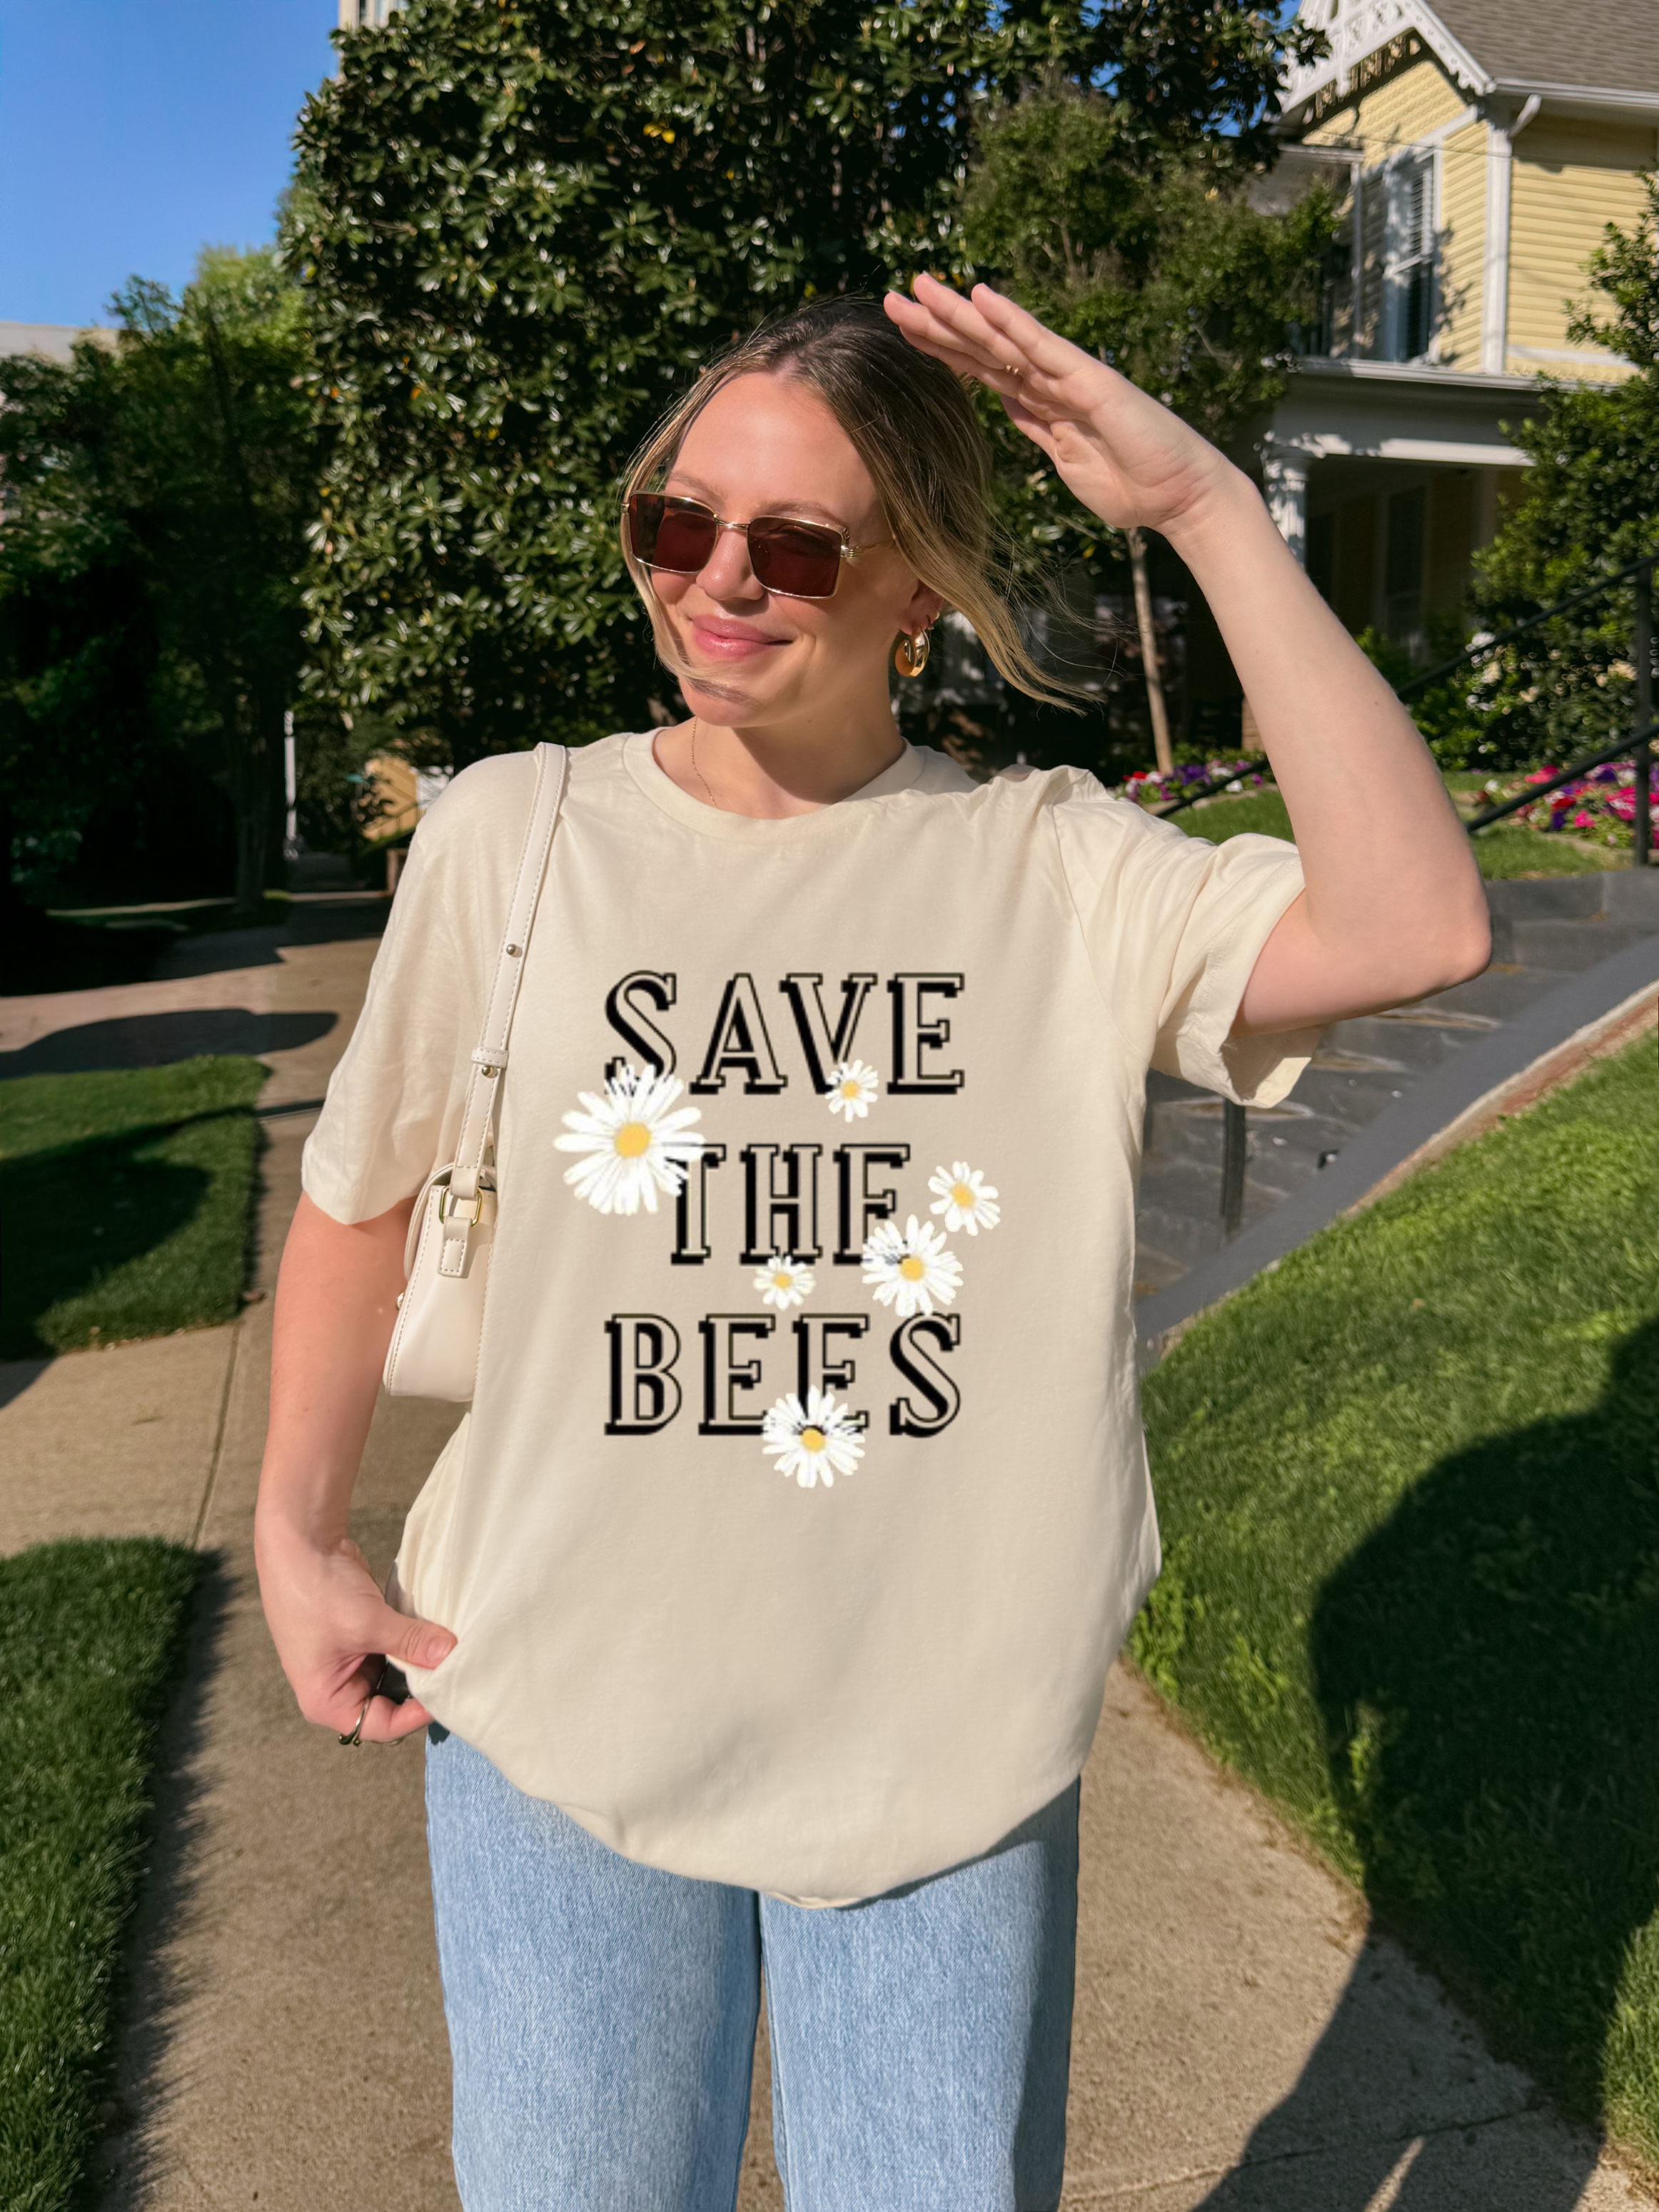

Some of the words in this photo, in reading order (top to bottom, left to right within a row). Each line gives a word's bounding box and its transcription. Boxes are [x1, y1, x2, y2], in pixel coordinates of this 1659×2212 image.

[604, 970, 964, 1096] SAVE
[661, 1142, 912, 1265] THE
[604, 1312, 962, 1438] BEES
